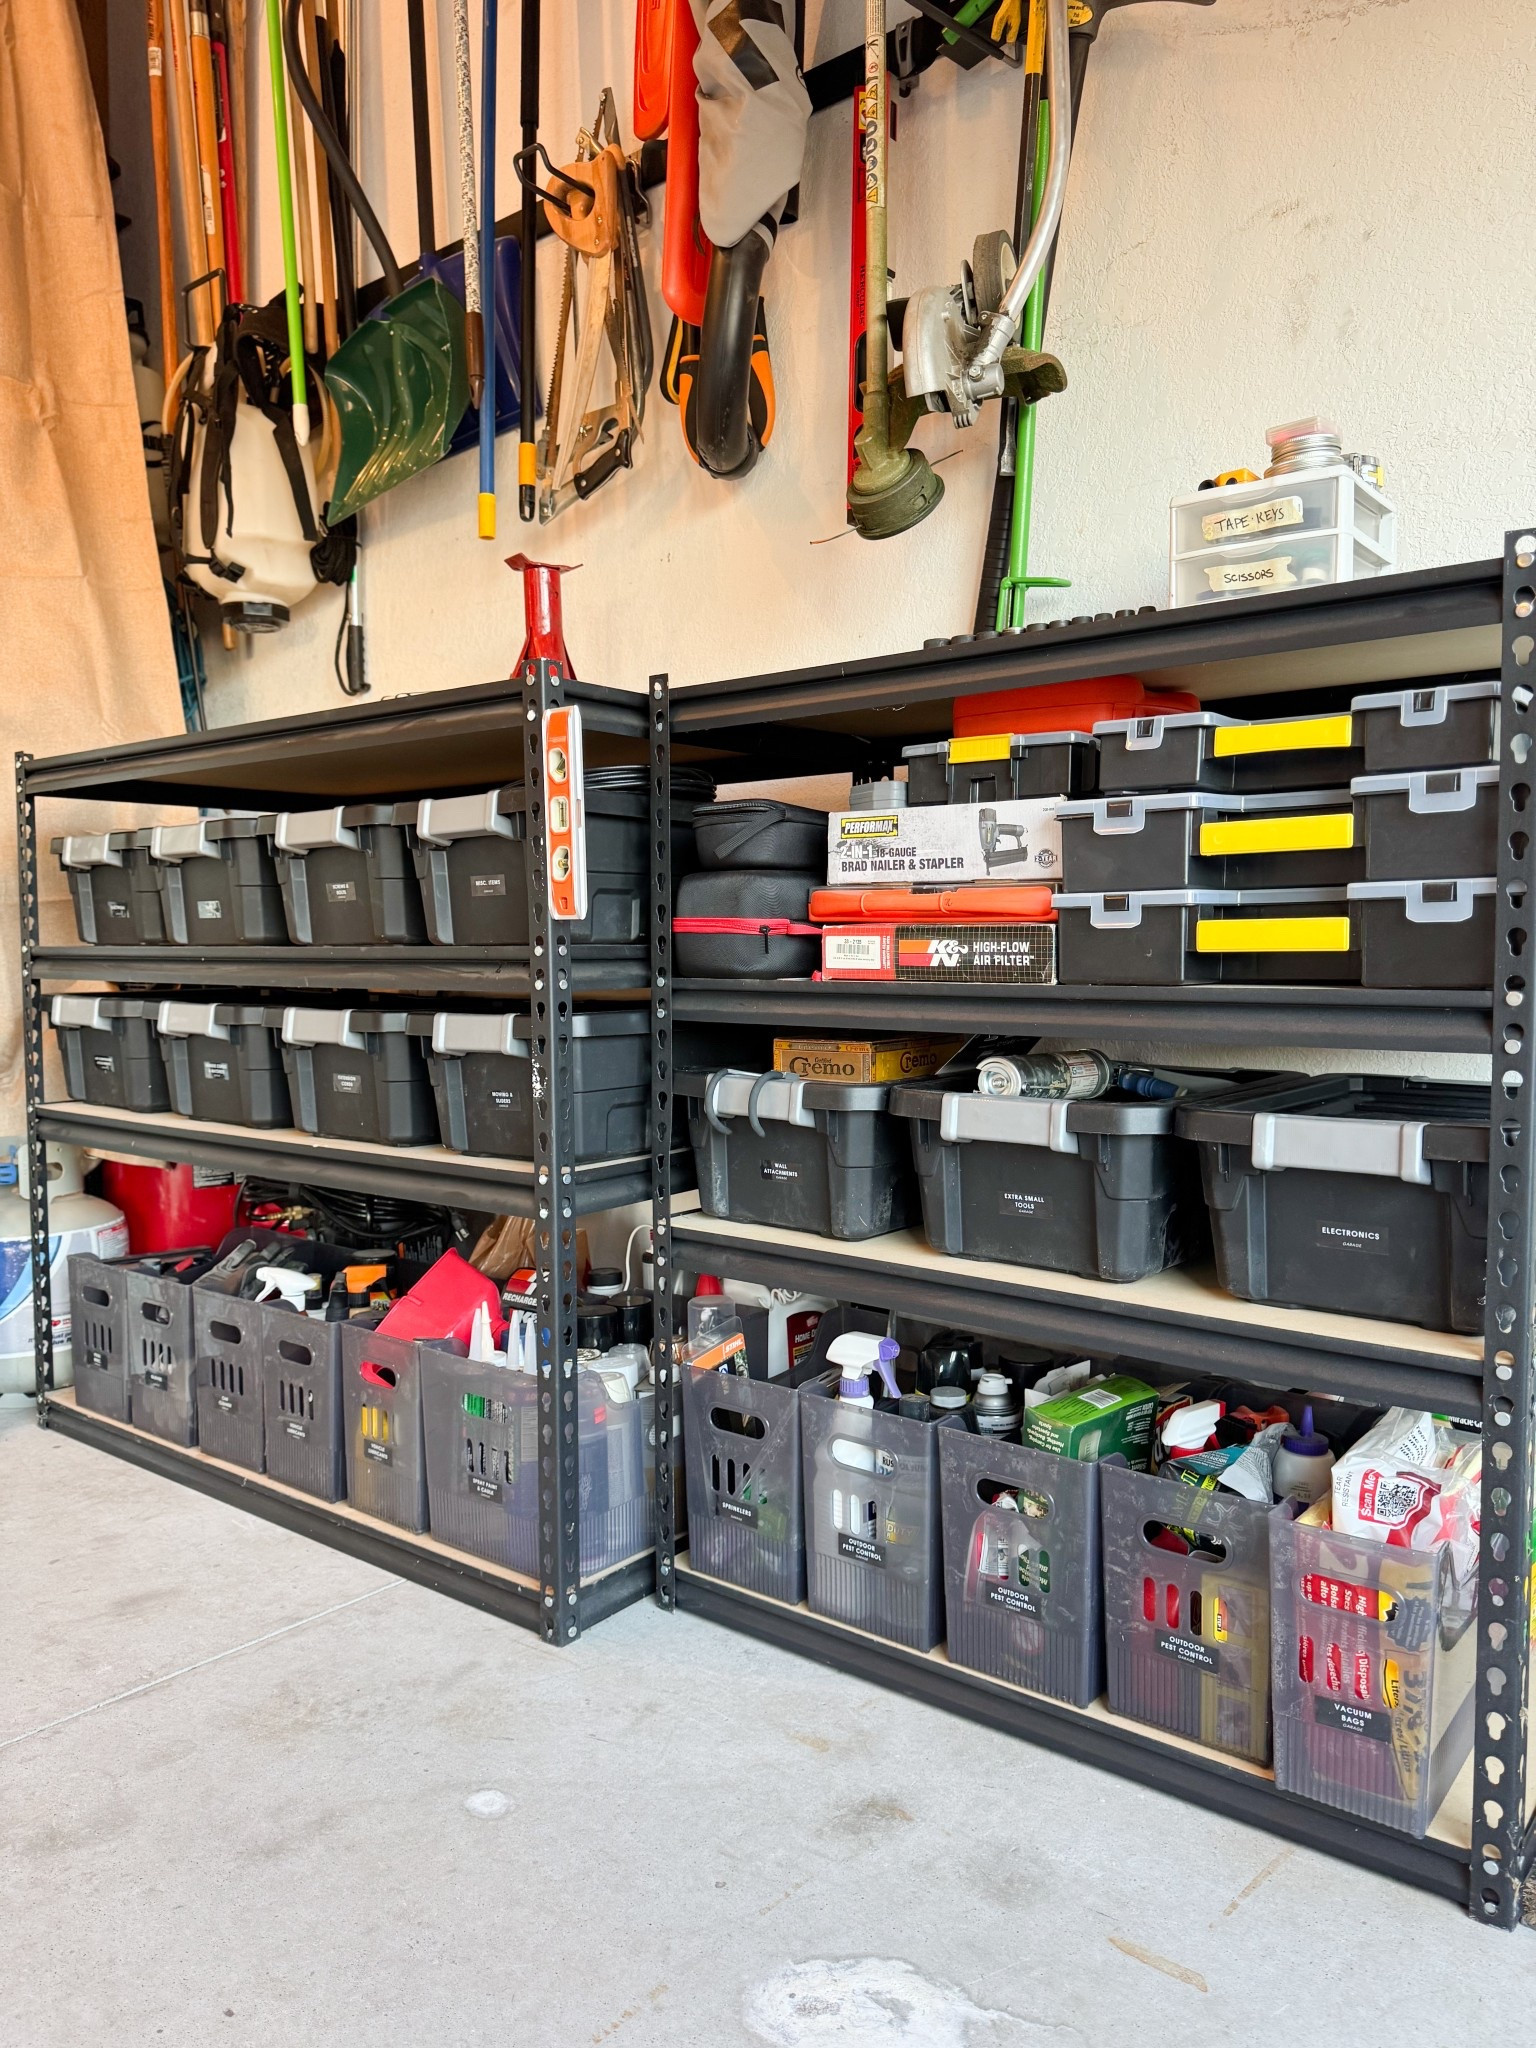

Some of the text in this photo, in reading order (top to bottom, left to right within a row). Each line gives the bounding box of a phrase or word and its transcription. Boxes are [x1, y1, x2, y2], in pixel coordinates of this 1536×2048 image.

[1256, 507, 1285, 522] KEYS
[1223, 568, 1274, 584] SCISSORS
[844, 819, 893, 835] PERFORMAX
[840, 844, 917, 860] 2-IN-1 18-GAUGE
[841, 857, 964, 873] BRAD NAILER & STAPLER
[973, 941, 1030, 953] HIGH-FLOW
[973, 955, 991, 966] AIR
[763, 1168, 798, 1177] ATTACHMENTS
[774, 1162, 788, 1170] WALL
[1004, 1193, 1045, 1203] EXTRA SMALL
[1014, 1201, 1035, 1210] TOOLS
[1321, 1226, 1380, 1241] ELECTRONICS
[725, 1338, 744, 1353] STIHL
[1334, 1475, 1343, 1496] TEAR
[722, 1501, 752, 1517] SPRINKLERS
[1360, 1489, 1375, 1517] Scan
[842, 1543, 882, 1562] PEST CONTROL
[848, 1538, 876, 1551] OUTDOOR
[997, 1586, 1029, 1602] OUTDOOR
[1344, 1589, 1354, 1610] Sacs
[990, 1592, 1037, 1613] PEST CONTROL
[1169, 1635, 1205, 1653] OUTDOOR
[1160, 1641, 1214, 1665] PEST CONTROL
[1334, 1703, 1372, 1719] VACUUM
[1340, 1715, 1365, 1728] BAGS
[1342, 1723, 1363, 1733] GARAGE
